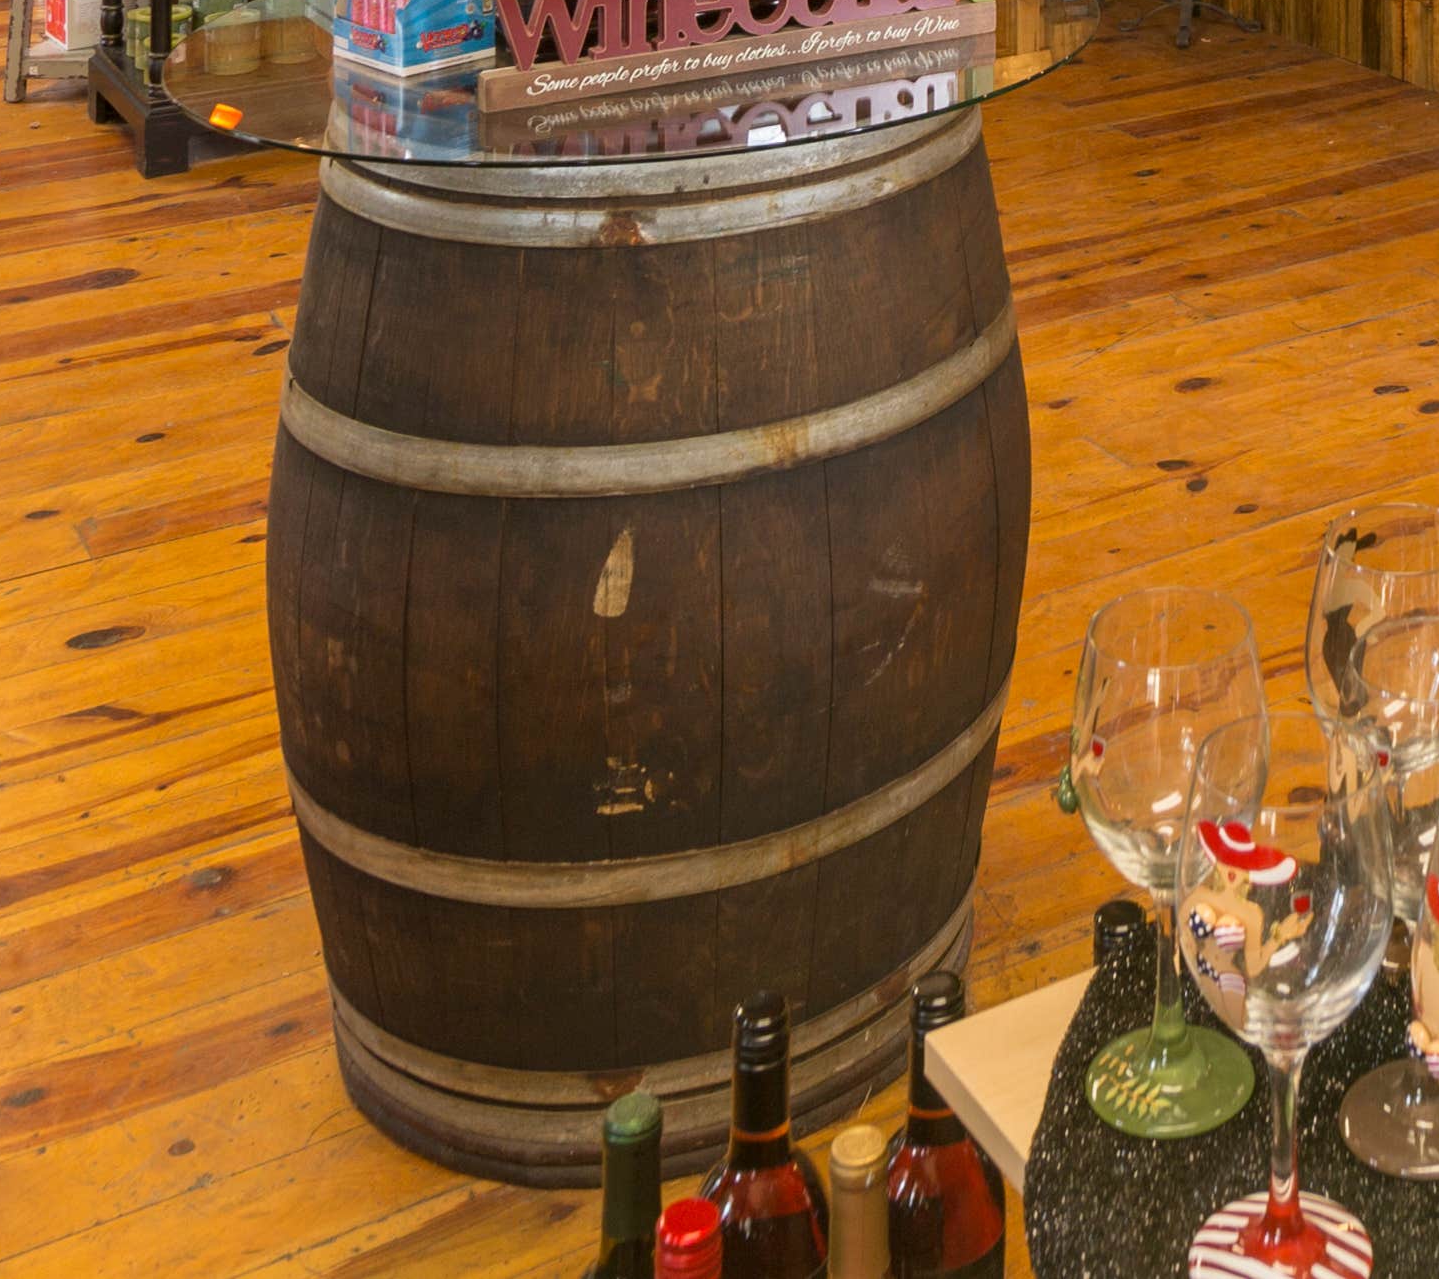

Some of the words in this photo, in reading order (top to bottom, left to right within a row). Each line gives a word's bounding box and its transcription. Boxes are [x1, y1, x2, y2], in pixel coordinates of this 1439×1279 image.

[526, 74, 578, 96] Some
[579, 66, 629, 90] people
[630, 58, 682, 83] prefer
[684, 57, 698, 70] to
[703, 53, 734, 69] buy
[816, 30, 864, 54] prefer
[866, 29, 882, 42] to
[884, 25, 911, 42] buy
[914, 16, 960, 37] Wine
